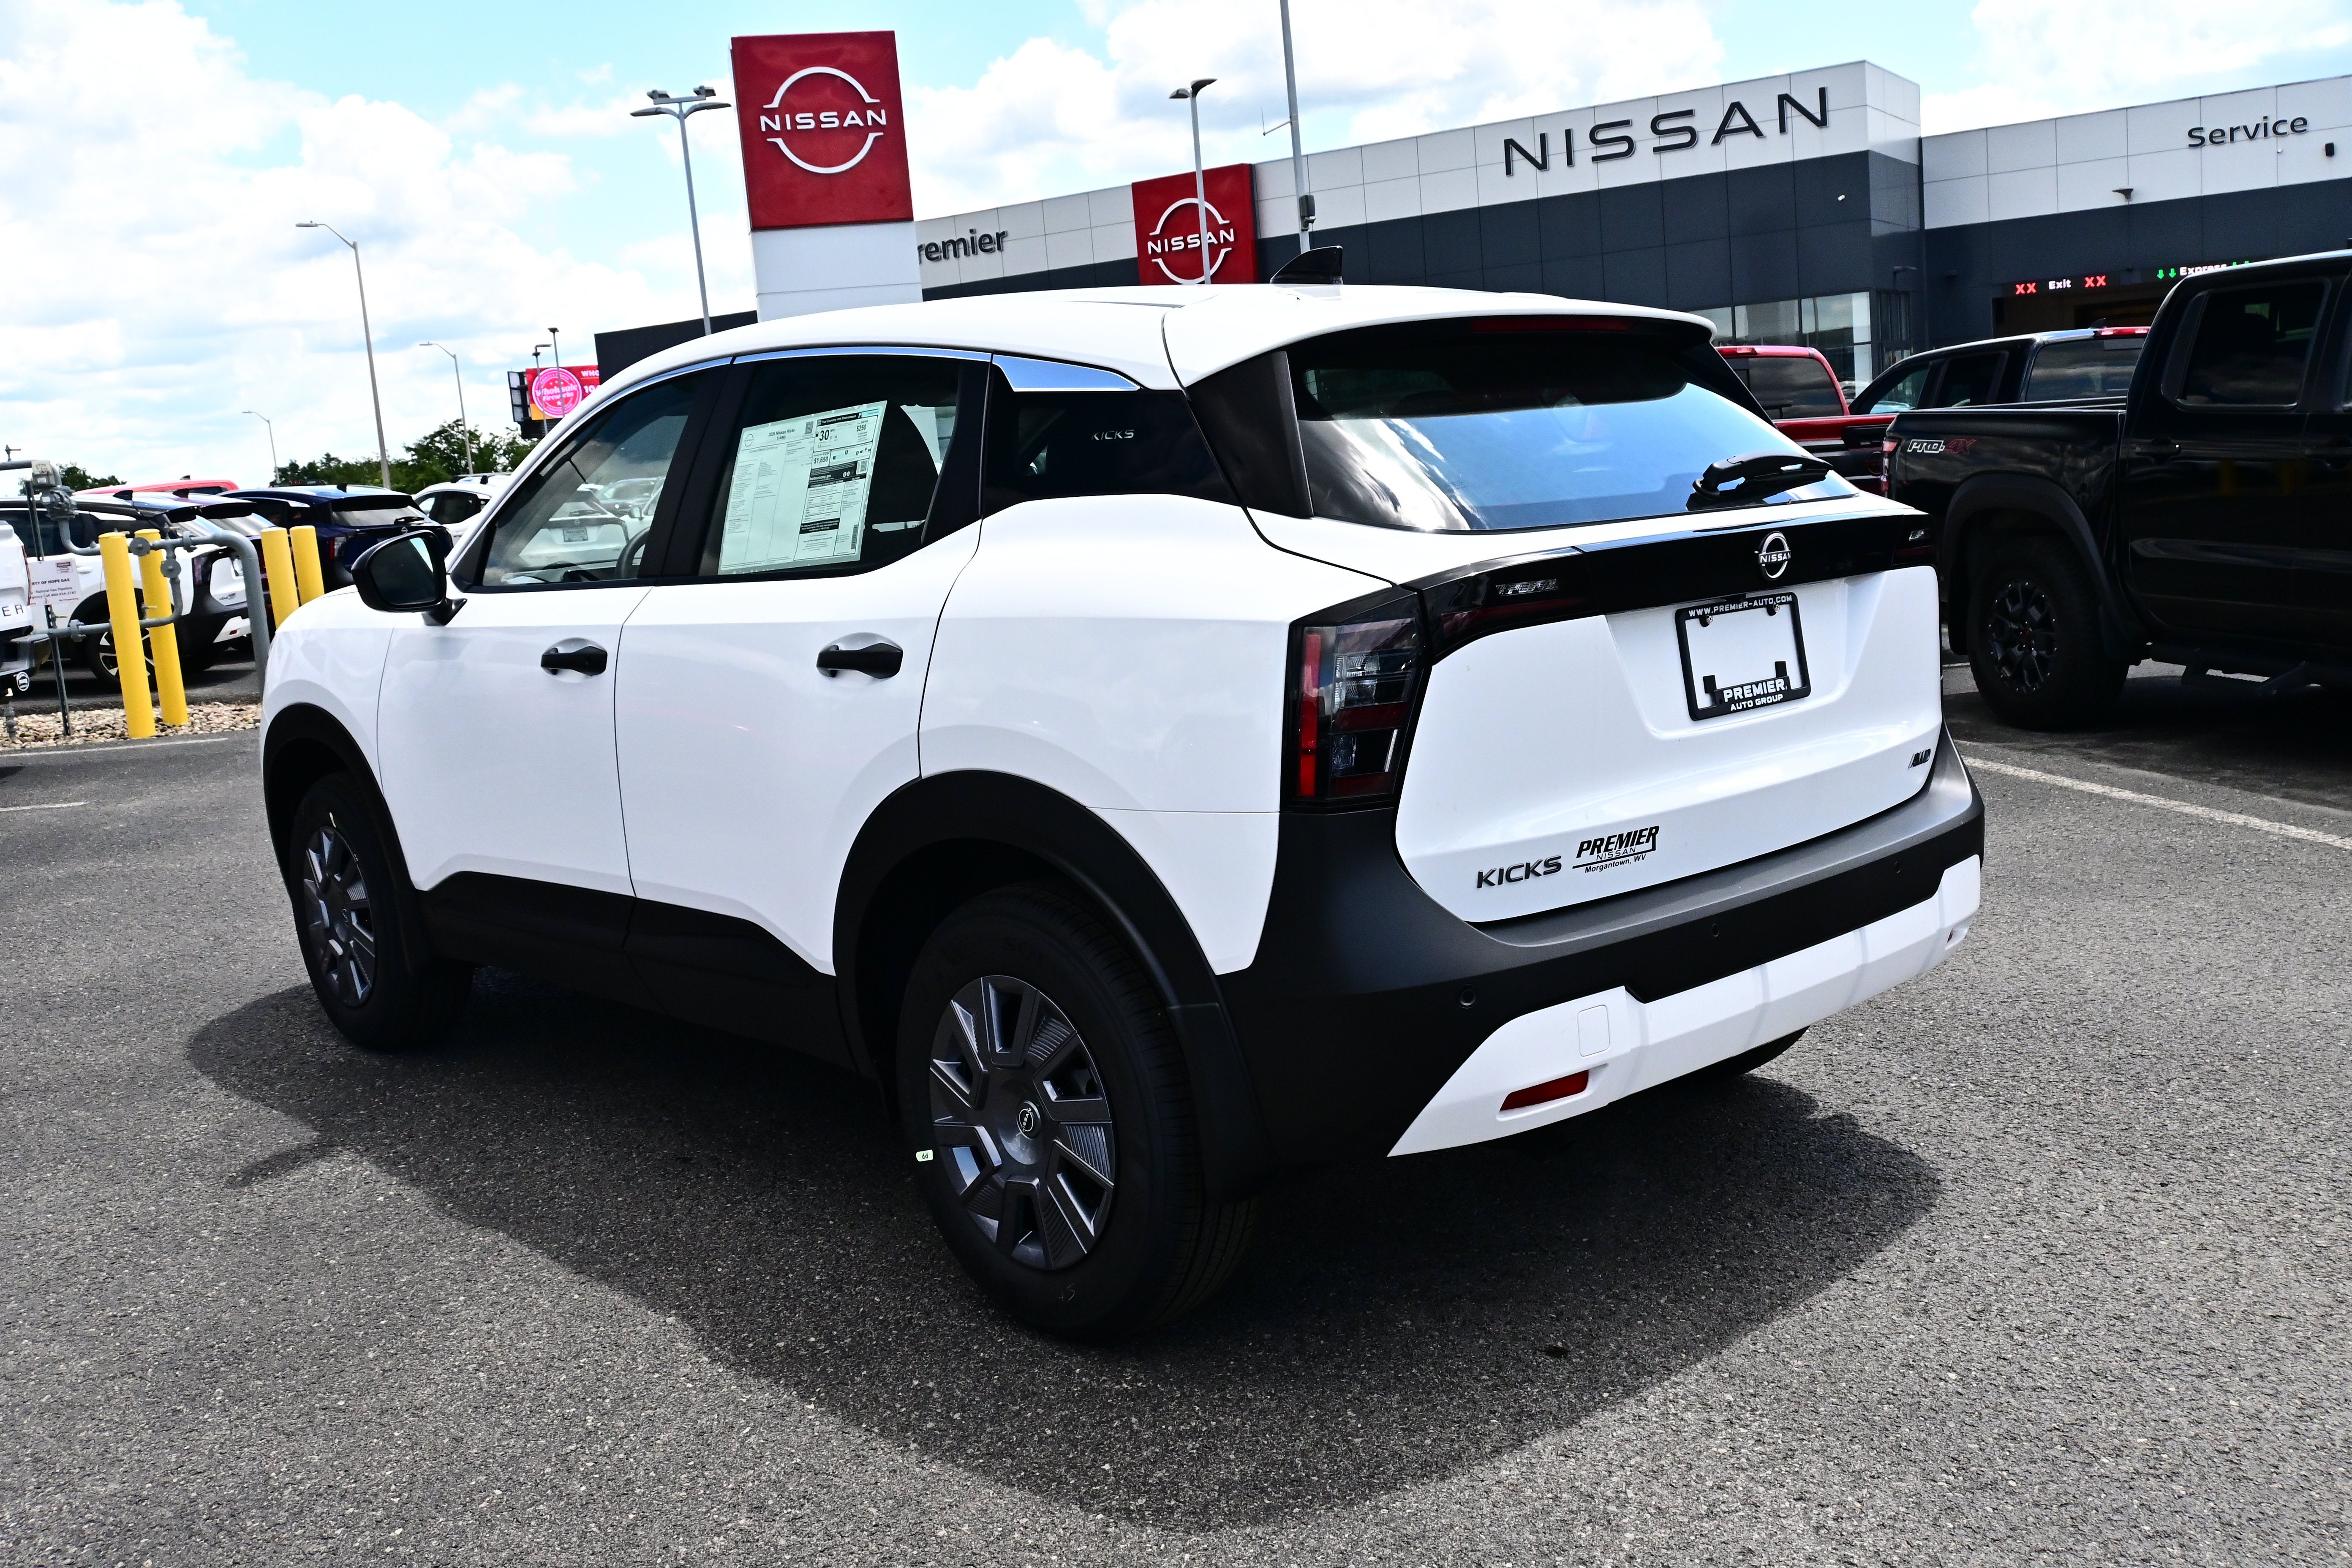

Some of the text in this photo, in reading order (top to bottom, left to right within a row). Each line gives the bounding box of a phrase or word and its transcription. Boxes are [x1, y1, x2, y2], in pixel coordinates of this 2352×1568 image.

[761, 109, 886, 132] NISSAN
[1504, 87, 1829, 176] NISSAN
[2188, 116, 2308, 148] Service
[917, 229, 1008, 264] remier
[1148, 229, 1234, 254] NISSAN
[2049, 279, 2071, 289] Exit
[543, 392, 574, 401] Firewrks
[819, 430, 829, 441] 30
[1092, 430, 1135, 440] KICKS
[1760, 553, 1791, 563] NISSAN
[1, 604, 24, 617] ER
[1689, 595, 1792, 617] WWW.PREMIER-AUTO.COM
[1723, 679, 1785, 702] PREMIER
[1730, 694, 1783, 711] AUTO GROUP
[1576, 825, 1660, 858] PREMIER
[1585, 853, 1646, 873] Morgantown, WV
[1596, 847, 1636, 860] NISSAN
[1477, 855, 1562, 889] KICKS
[1022, 1108, 1032, 1132] NISSAN
